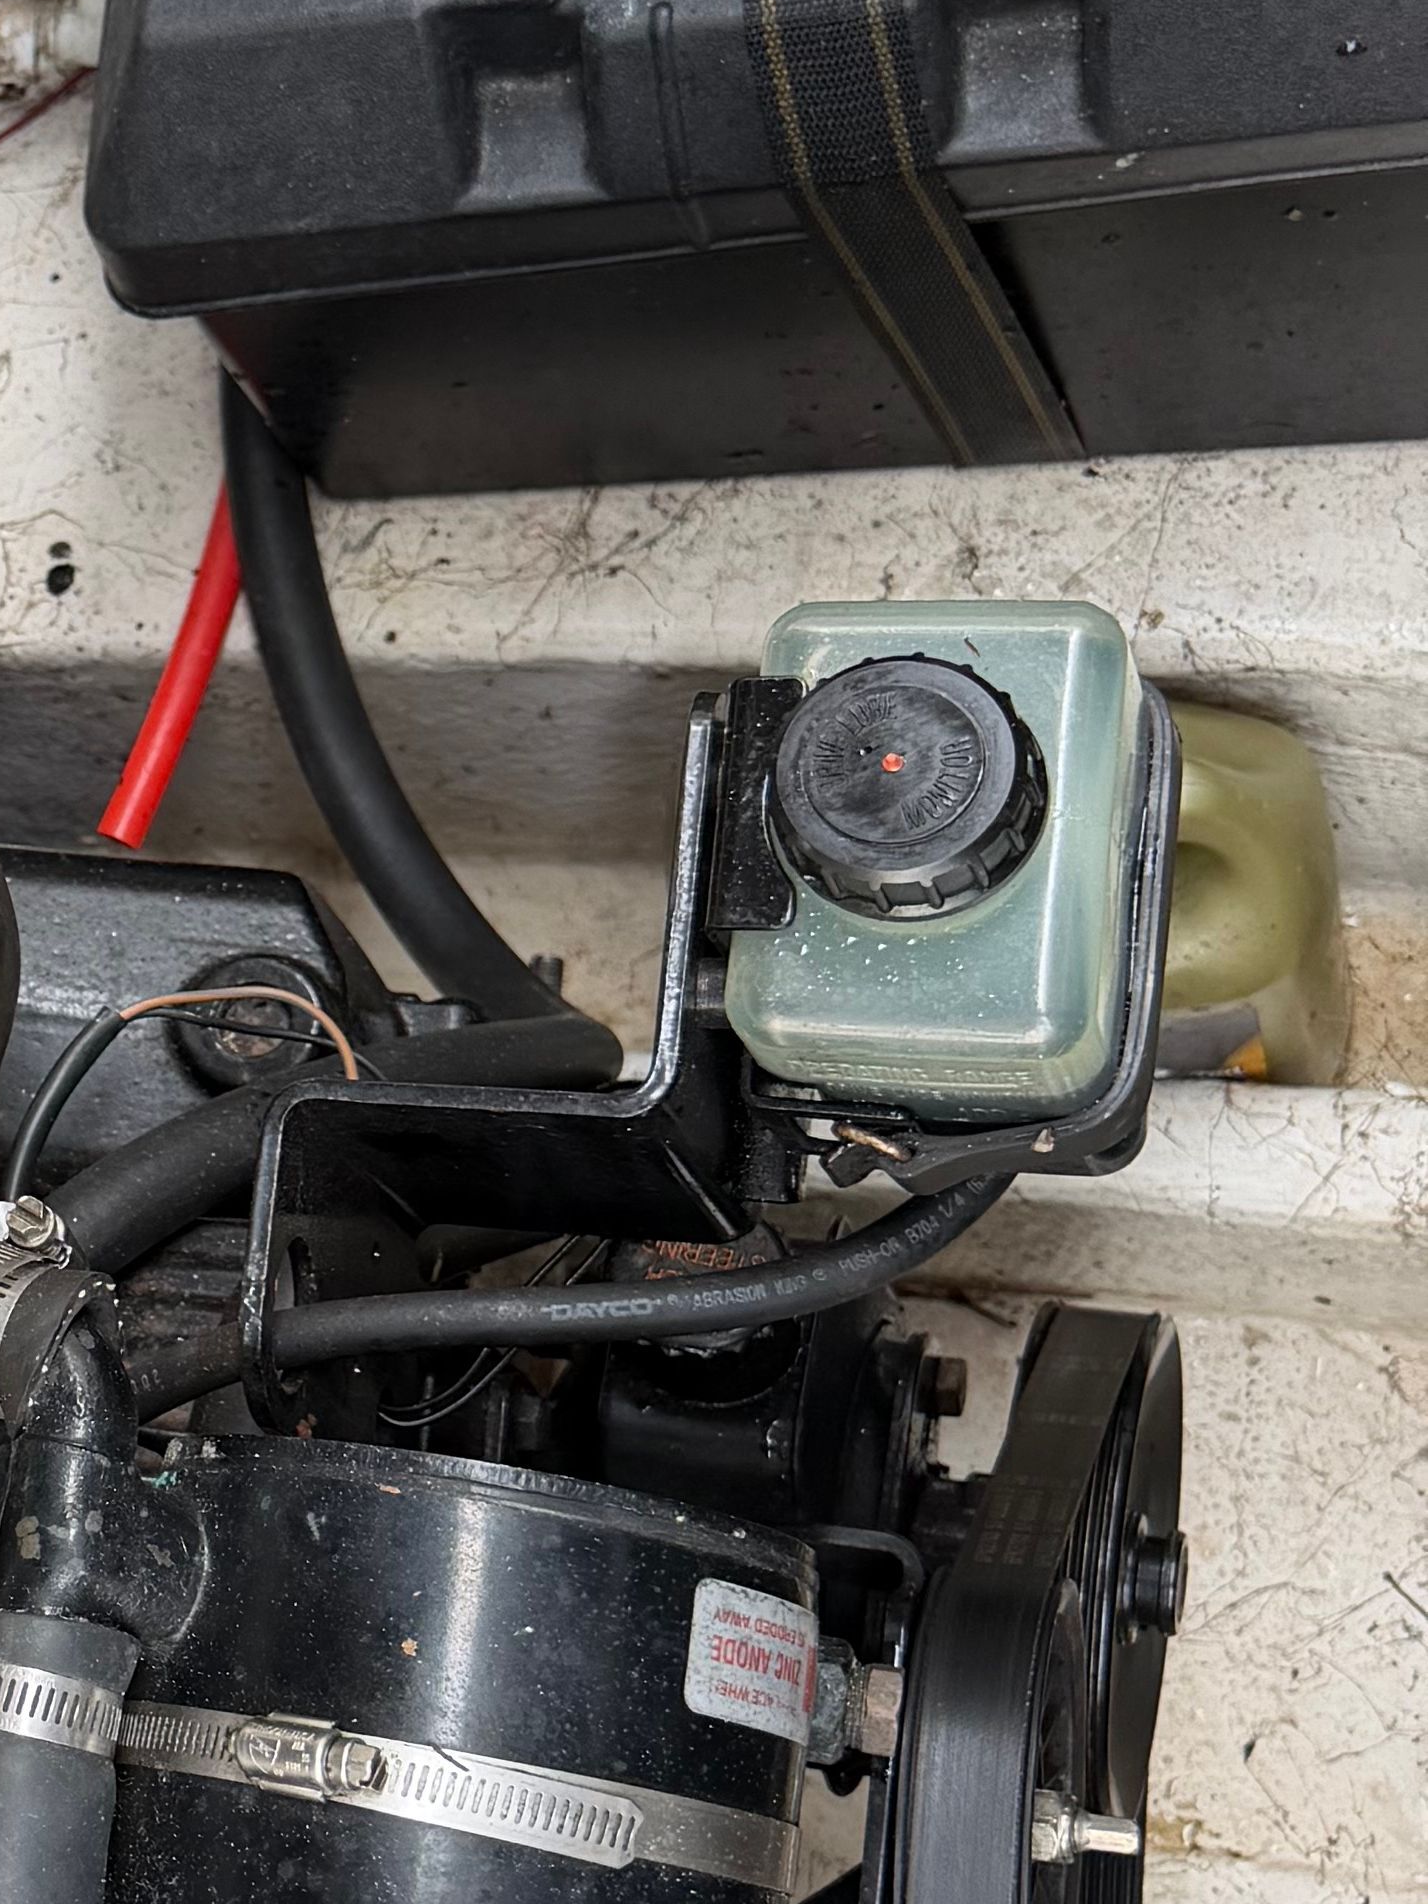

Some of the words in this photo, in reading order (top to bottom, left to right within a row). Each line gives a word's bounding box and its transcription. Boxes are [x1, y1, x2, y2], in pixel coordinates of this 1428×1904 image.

[784, 1058, 928, 1081] OPERATING
[943, 1067, 1033, 1087] RANGE
[689, 1280, 767, 1314] ABRASION
[772, 1271, 808, 1296] KING
[547, 1296, 656, 1324] DAYCO
[711, 1606, 750, 1631] AWAY
[753, 1618, 796, 1644] ERODED
[707, 1633, 771, 1676] ANODE
[772, 1652, 803, 1685] ZINC
